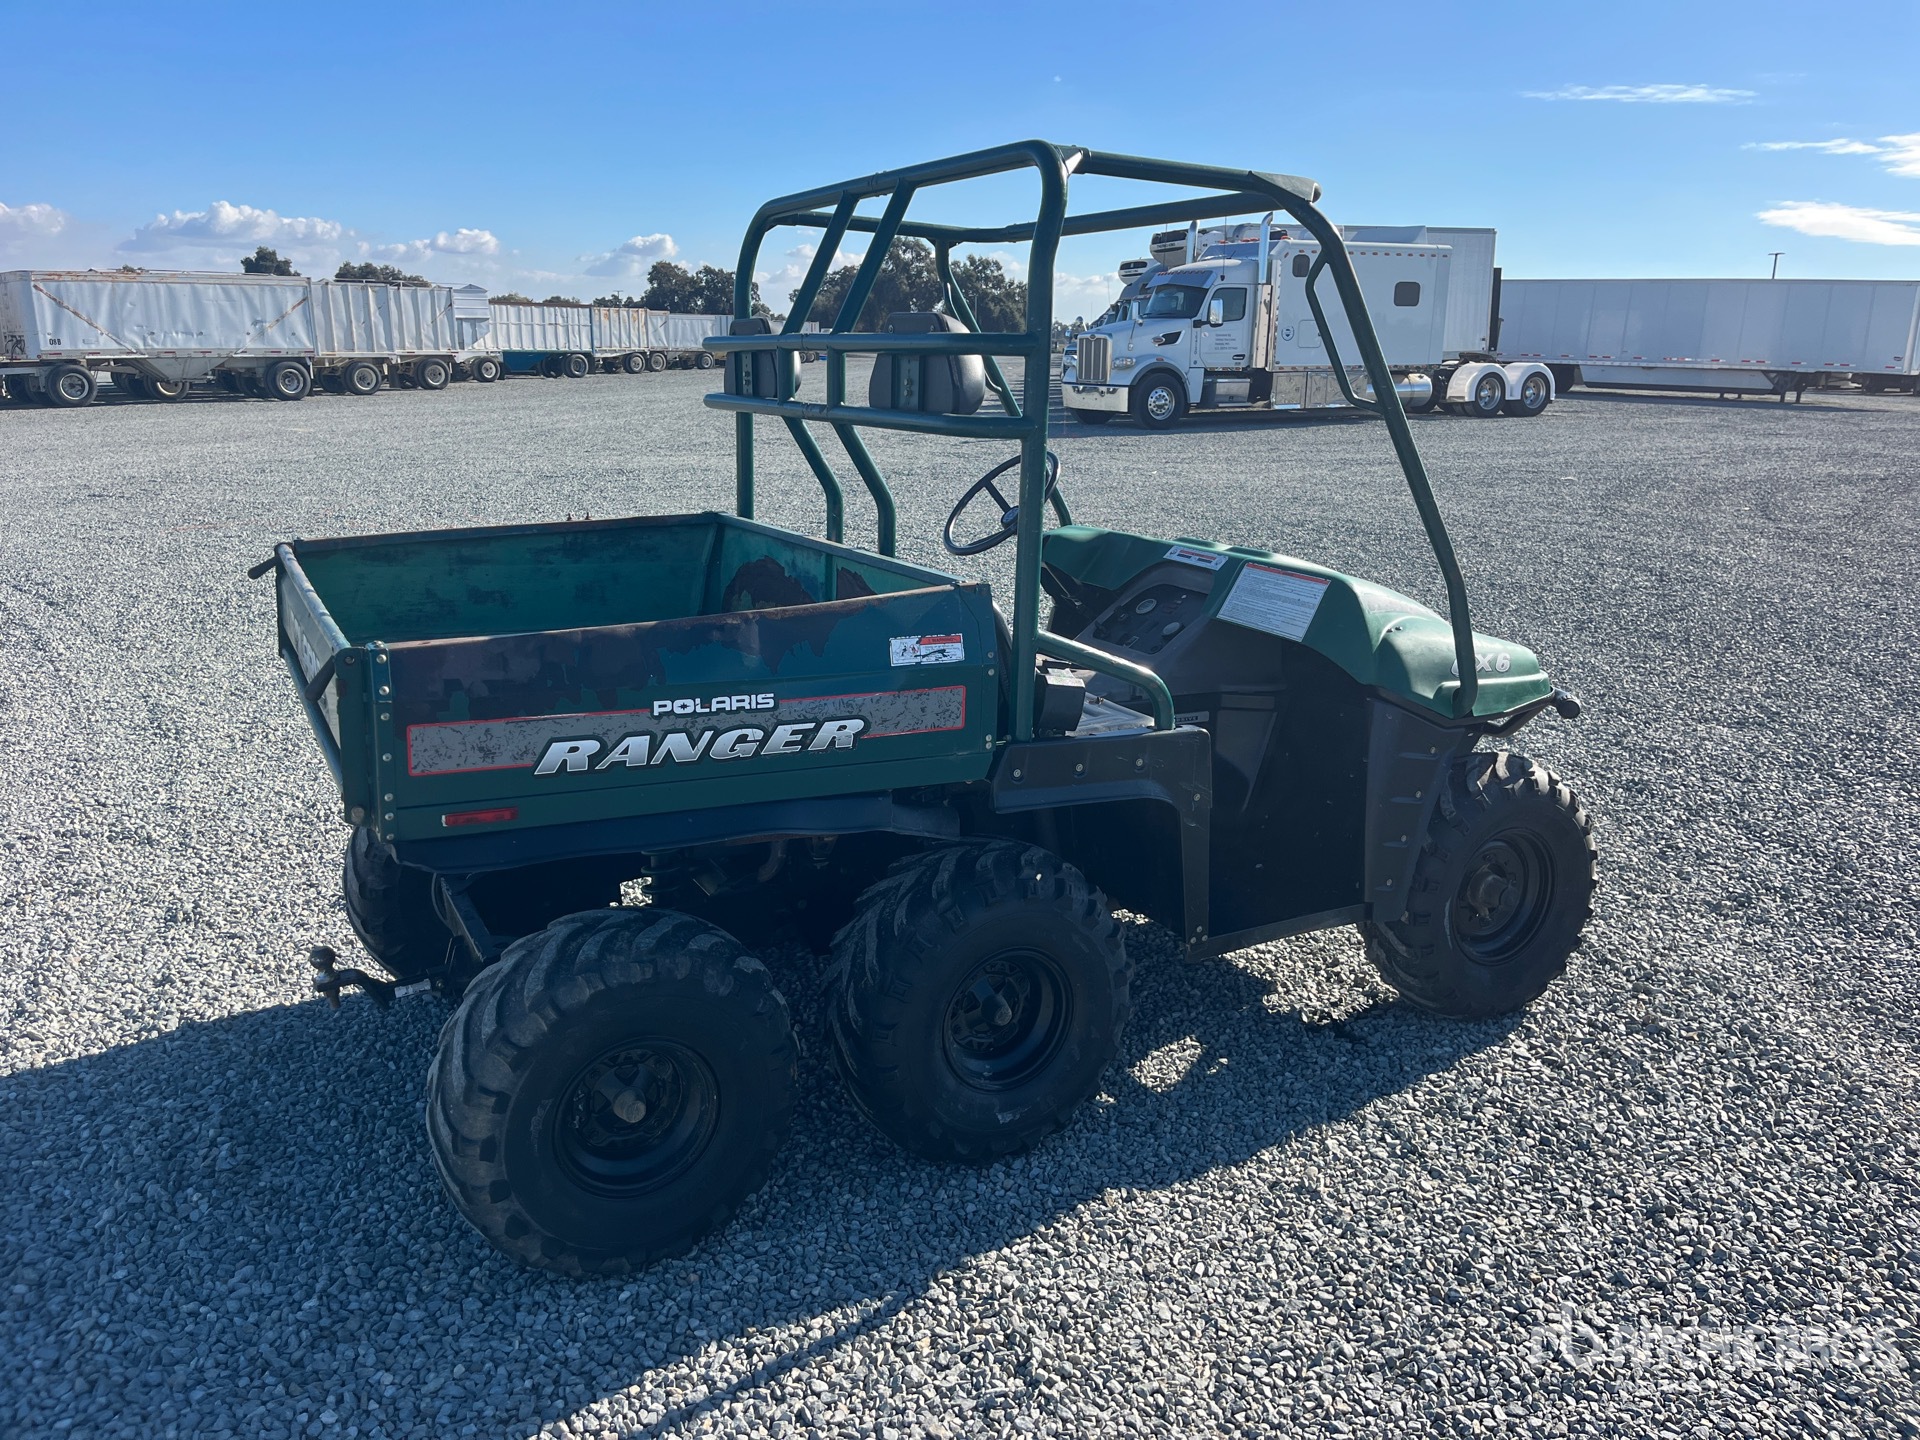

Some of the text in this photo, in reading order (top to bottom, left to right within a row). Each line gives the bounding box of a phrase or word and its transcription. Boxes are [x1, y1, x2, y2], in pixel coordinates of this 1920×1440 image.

[1451, 652, 1511, 678] X6
[653, 693, 775, 716] POLARIS
[534, 718, 866, 776] RANGER
